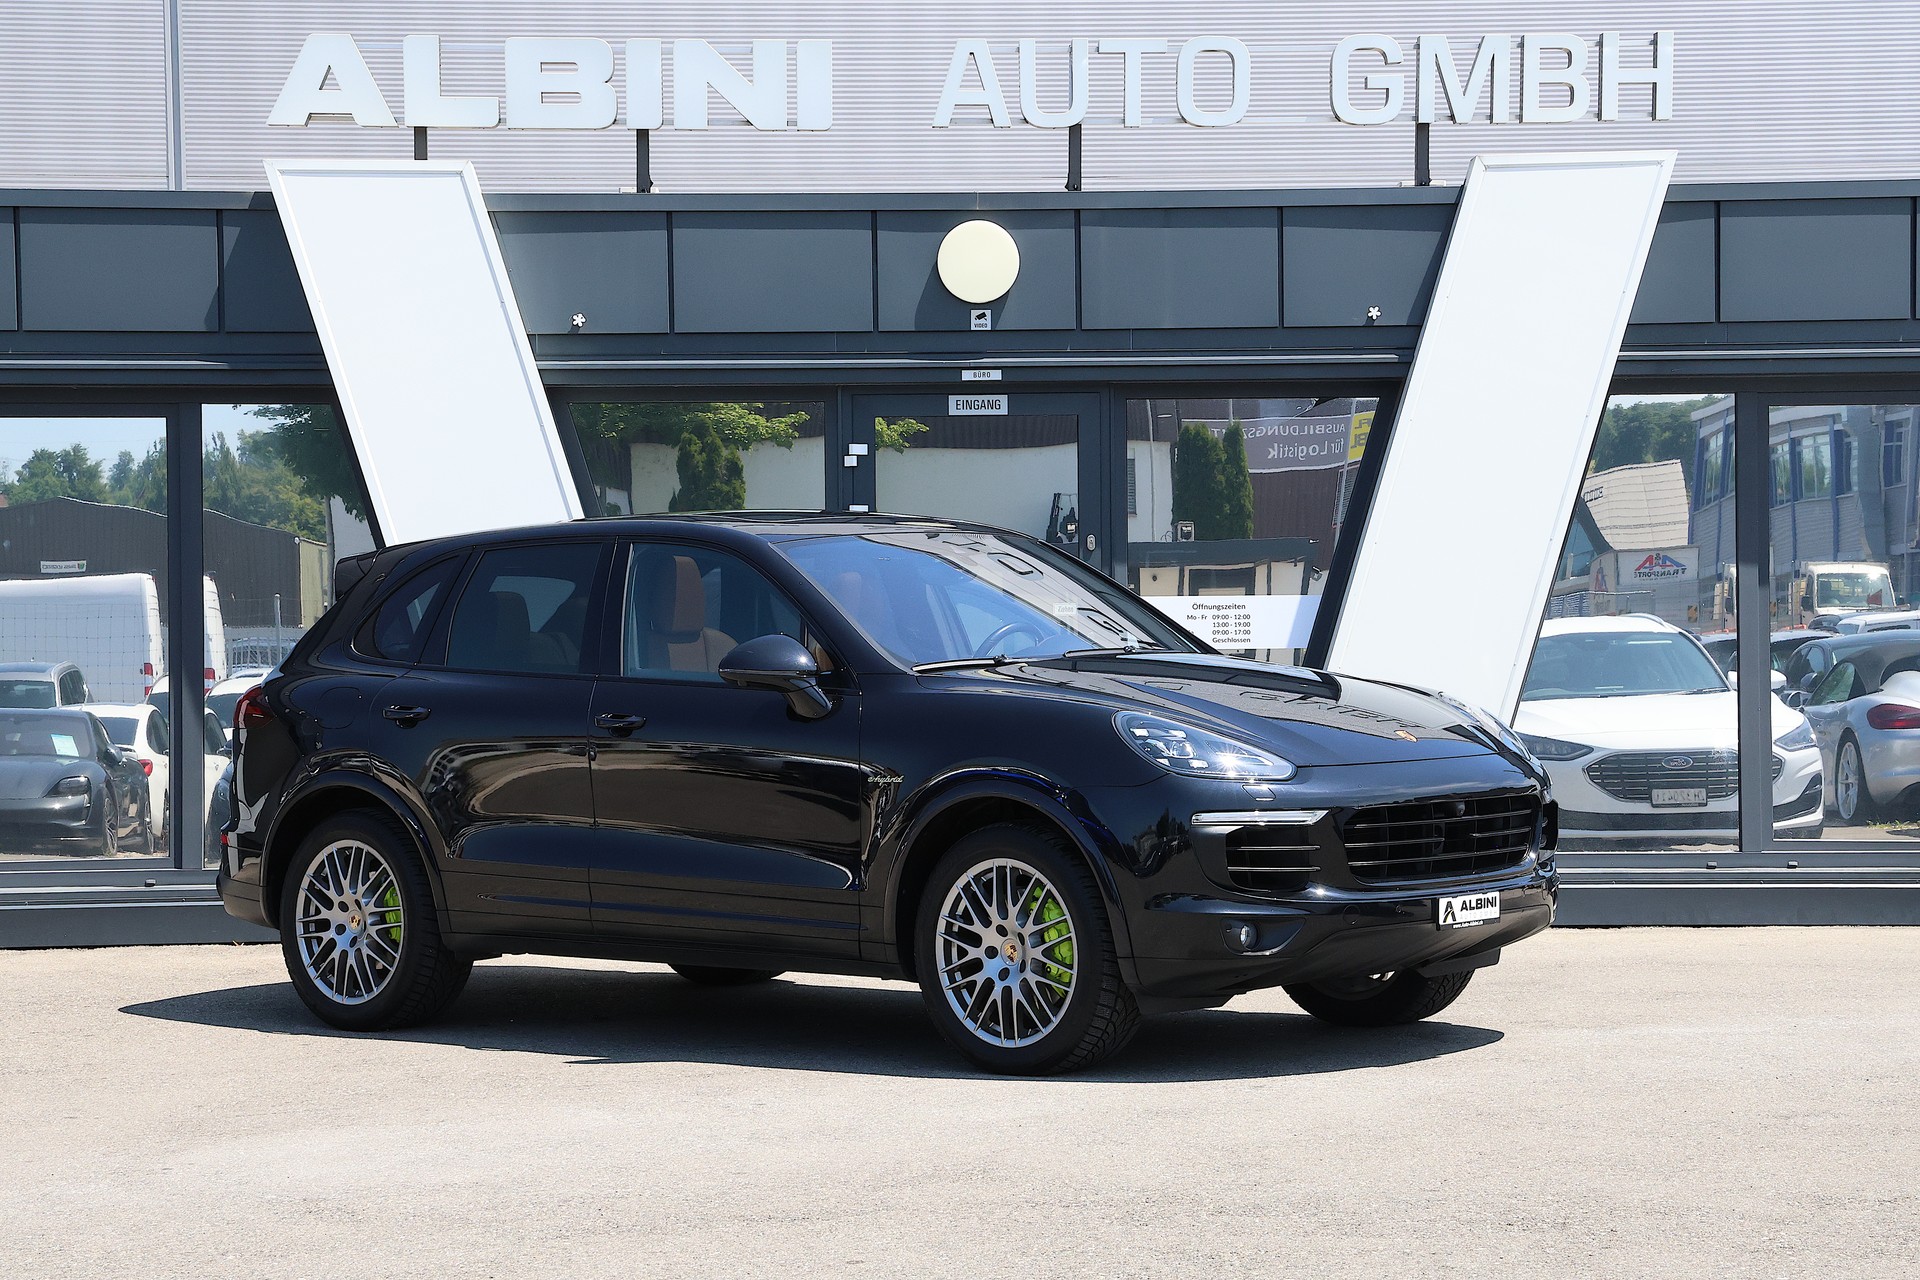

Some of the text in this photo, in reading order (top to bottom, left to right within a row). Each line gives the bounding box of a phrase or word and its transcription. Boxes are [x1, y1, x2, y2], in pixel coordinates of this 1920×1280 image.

[266, 30, 1675, 131] ALBINI AUTO GMBH
[955, 399, 1001, 410] EINGANG
[1192, 603, 1246, 611] Öffnungszeiten
[1460, 896, 1497, 912] ALBINI
